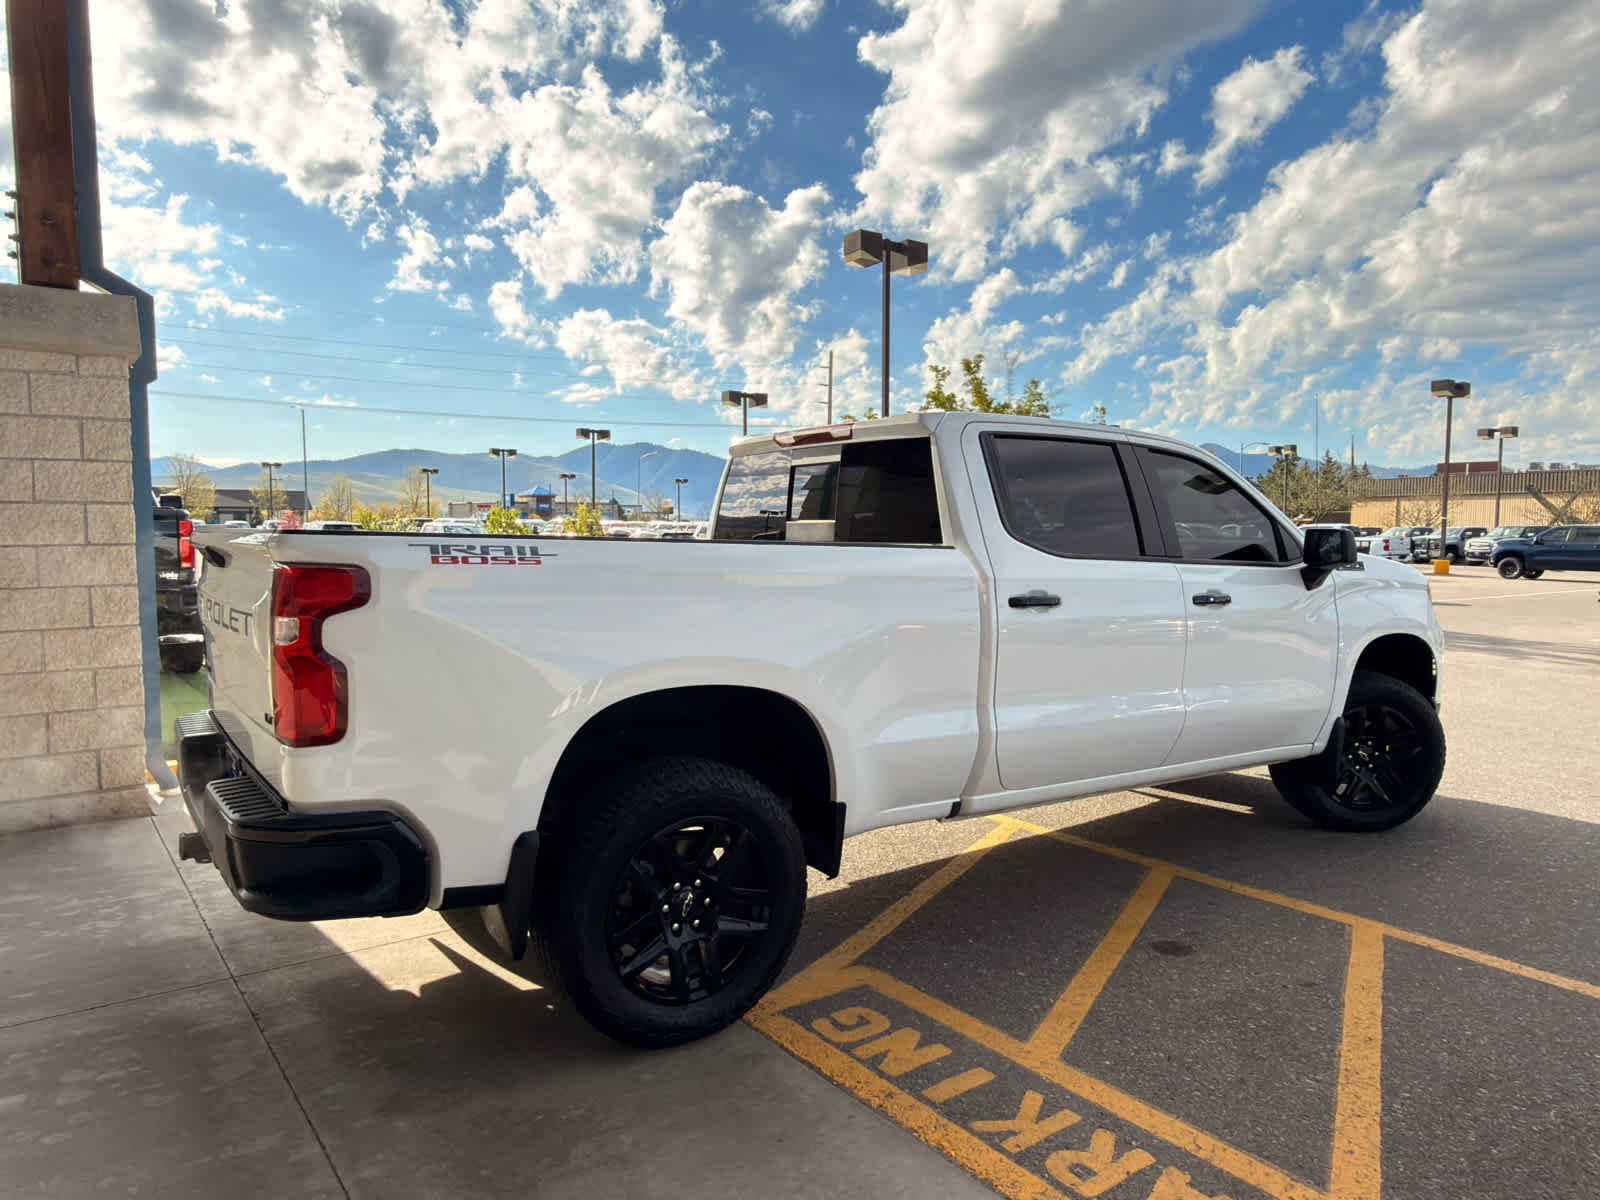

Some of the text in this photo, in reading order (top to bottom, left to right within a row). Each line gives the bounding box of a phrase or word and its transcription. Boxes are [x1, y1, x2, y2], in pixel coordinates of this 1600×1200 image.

[408, 543, 558, 556] TRAIL
[431, 556, 542, 565] BOSS
[202, 596, 253, 637] ROLET
